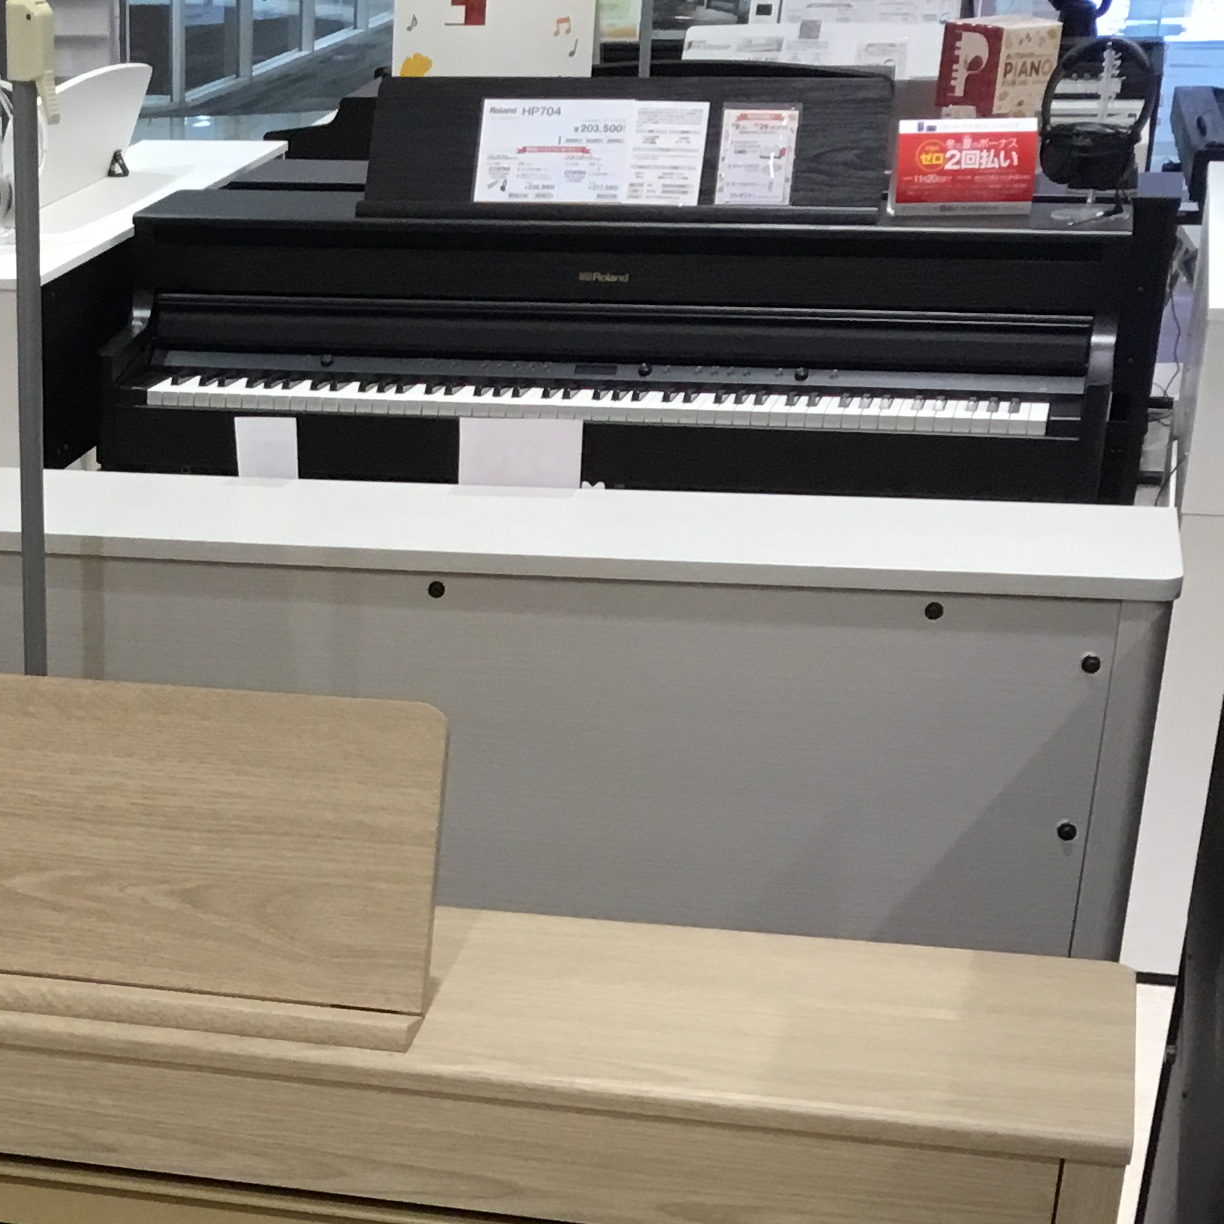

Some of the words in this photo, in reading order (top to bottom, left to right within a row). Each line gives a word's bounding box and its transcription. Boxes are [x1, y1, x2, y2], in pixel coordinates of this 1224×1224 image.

[1002, 57, 1053, 79] PIANO
[522, 106, 562, 116] HP704
[920, 152, 944, 165] ゼロ
[944, 149, 1019, 170] 2回払い
